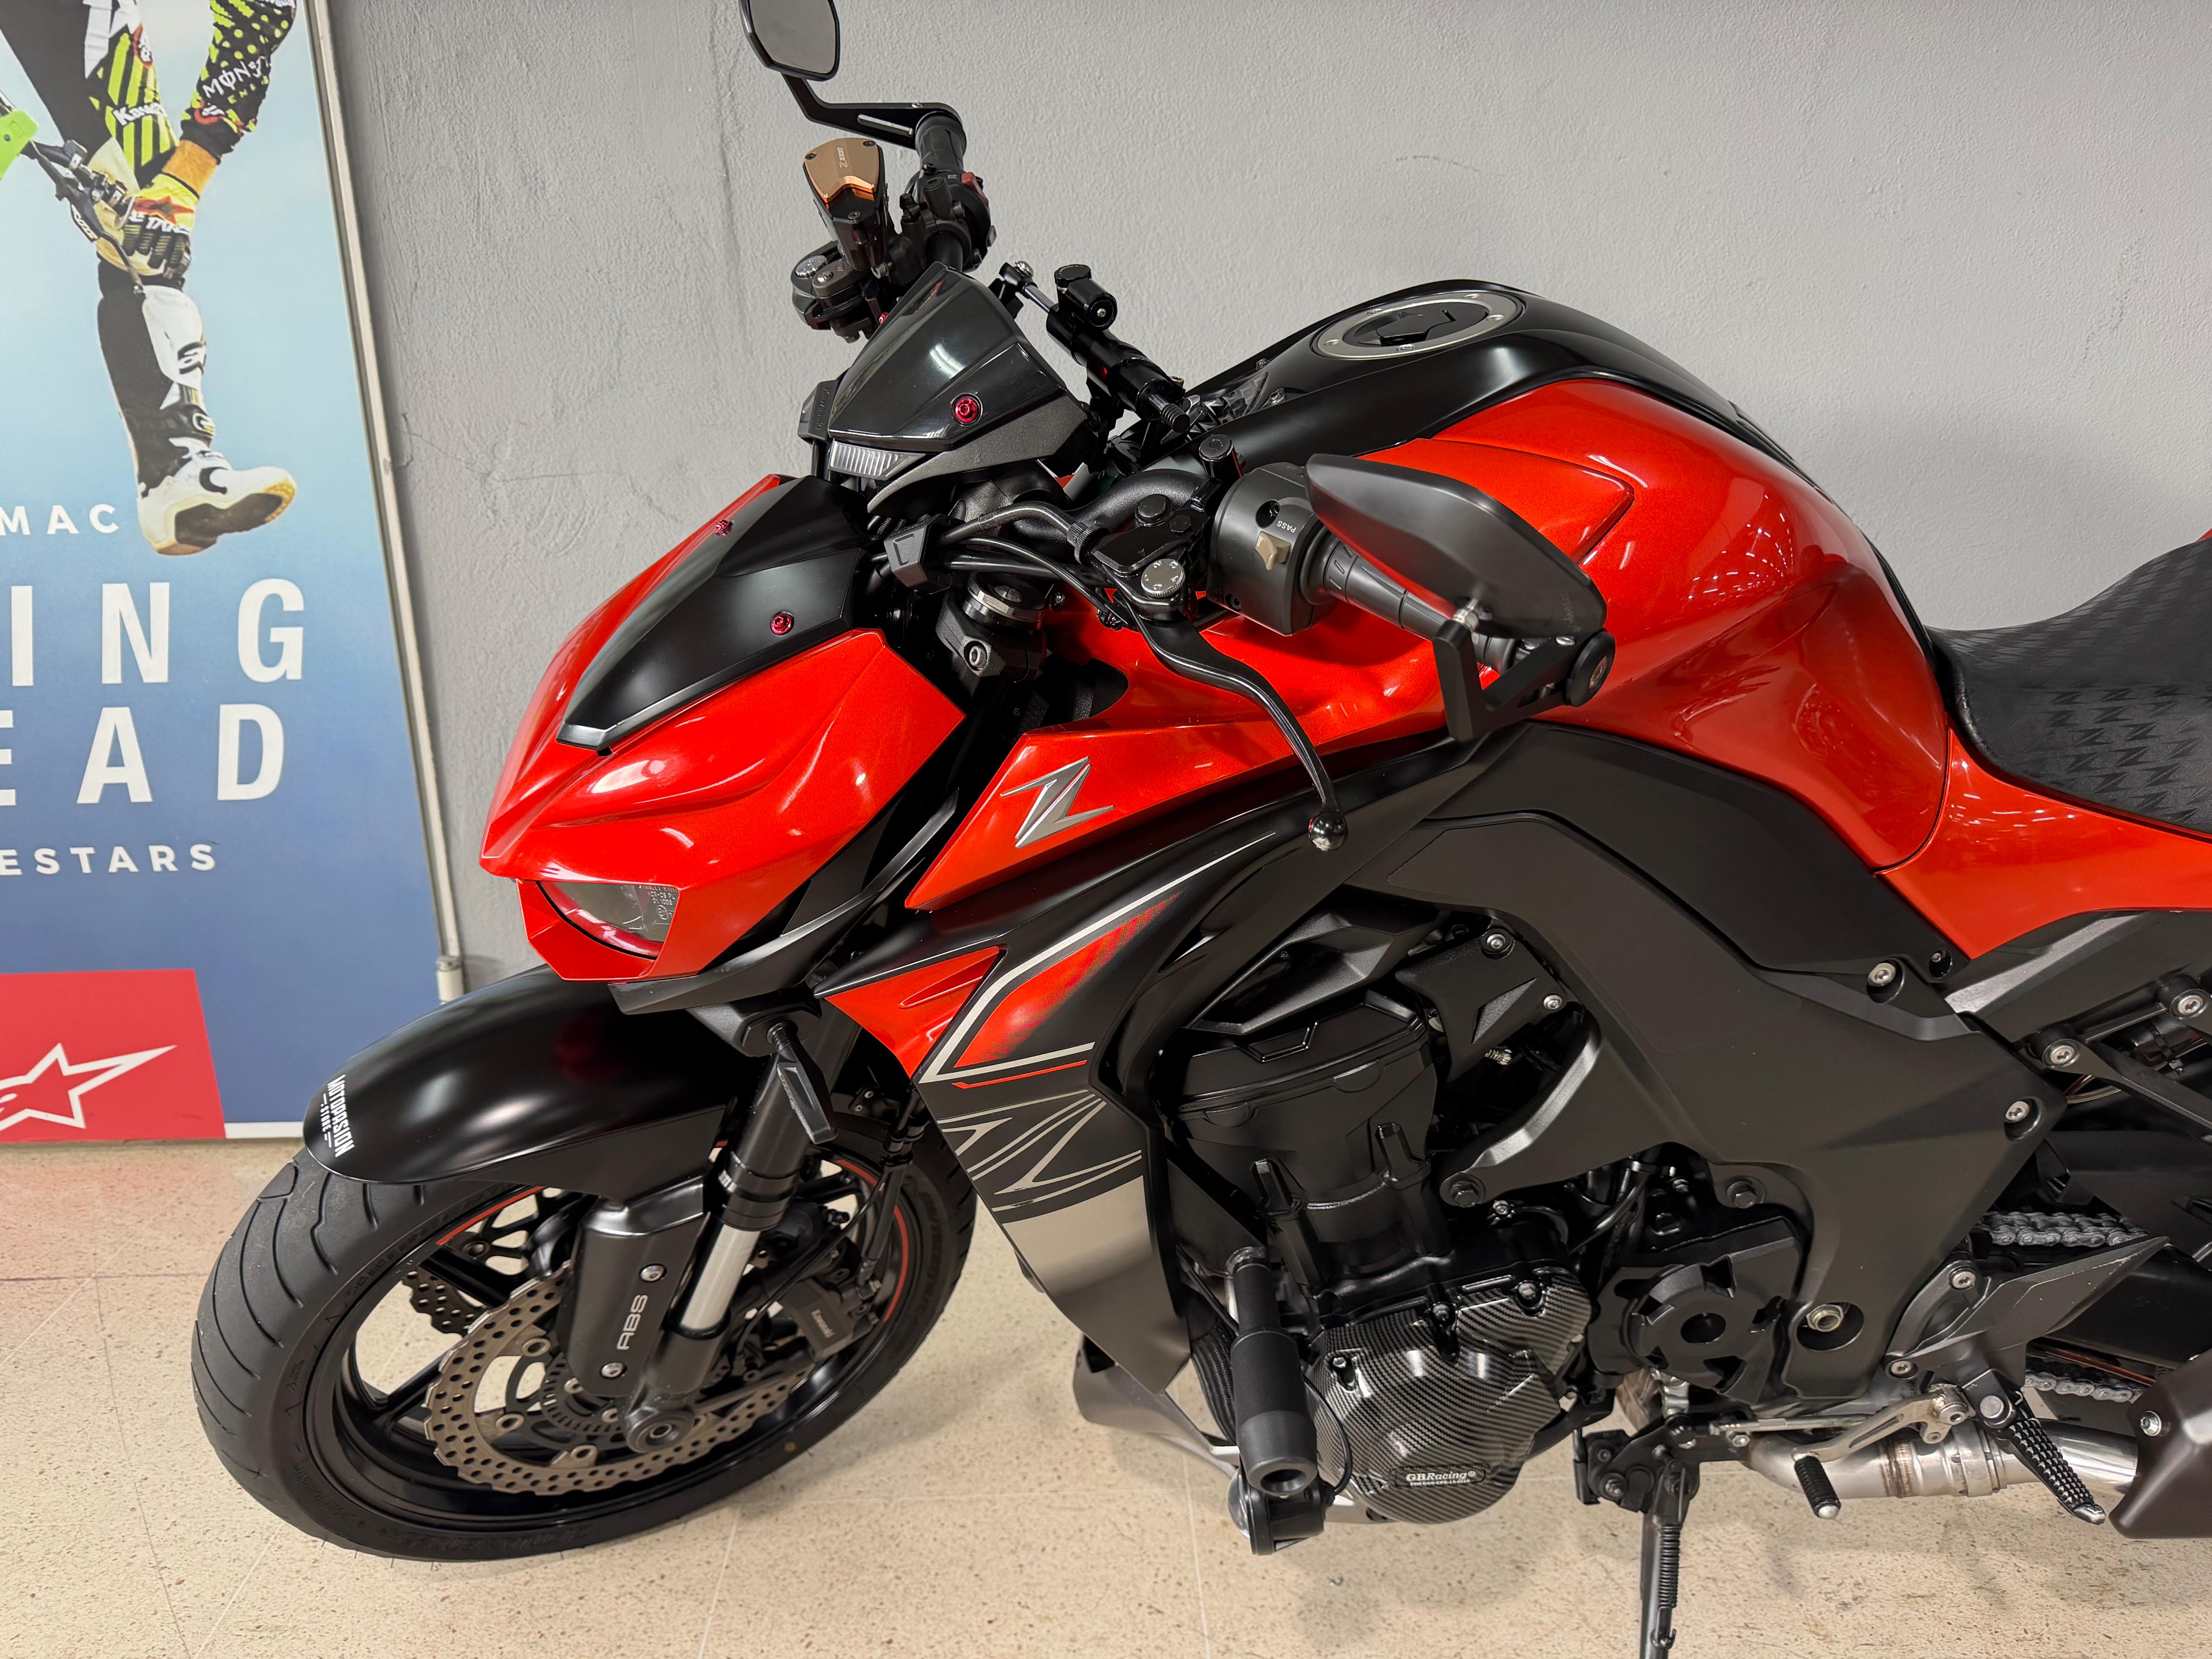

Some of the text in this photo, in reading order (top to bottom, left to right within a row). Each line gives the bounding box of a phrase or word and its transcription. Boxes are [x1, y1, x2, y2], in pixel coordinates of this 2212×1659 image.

[1277, 520, 1296, 533] PASS
[11, 578, 304, 686] ING
[327, 1074, 355, 1157] MOTOPASION
[617, 1294, 648, 1350] ABS
